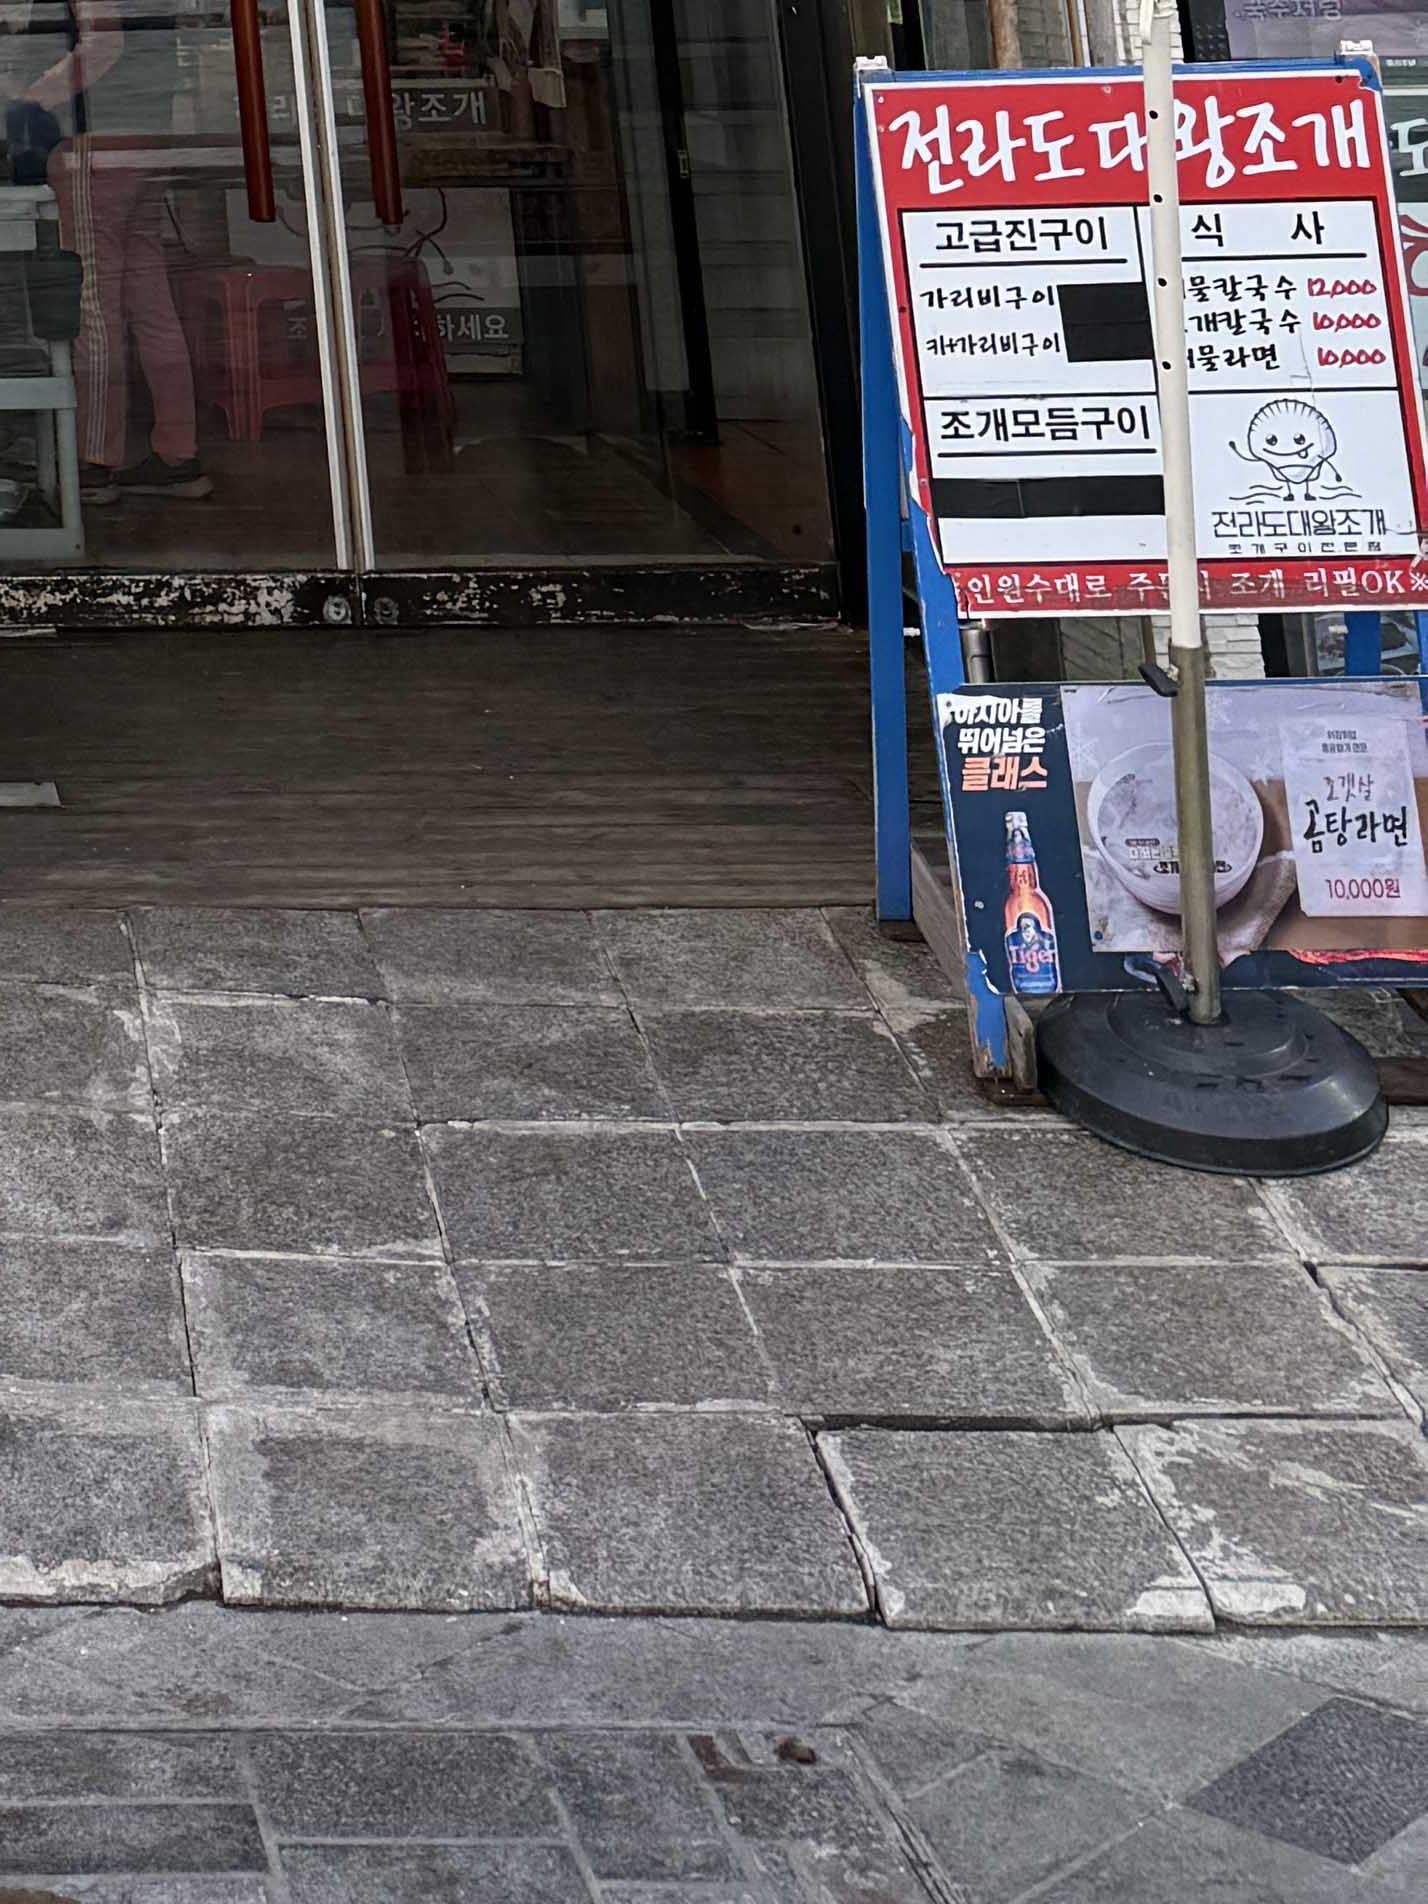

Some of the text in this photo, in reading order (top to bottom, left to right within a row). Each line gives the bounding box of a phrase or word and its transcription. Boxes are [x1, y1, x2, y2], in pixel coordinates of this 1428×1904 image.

[934, 216, 1110, 253] 고급진구이
[919, 283, 1057, 311] 가리비구이
[1182, 272, 1377, 303] 물칼국수 12,000
[1182, 308, 1382, 336] 개칼국수 10,000
[1185, 343, 1387, 373] 물라면 10,000
[940, 404, 1151, 442] 조개모듬구이
[1210, 507, 1387, 539] 전라도대왕조개
[957, 726, 1046, 755] 뛰어넘은
[961, 756, 1048, 792] 클래스
[1304, 799, 1408, 854] 곰탕라면
[1325, 877, 1401, 900] 10,000원
[1010, 944, 1057, 974] Tiger
